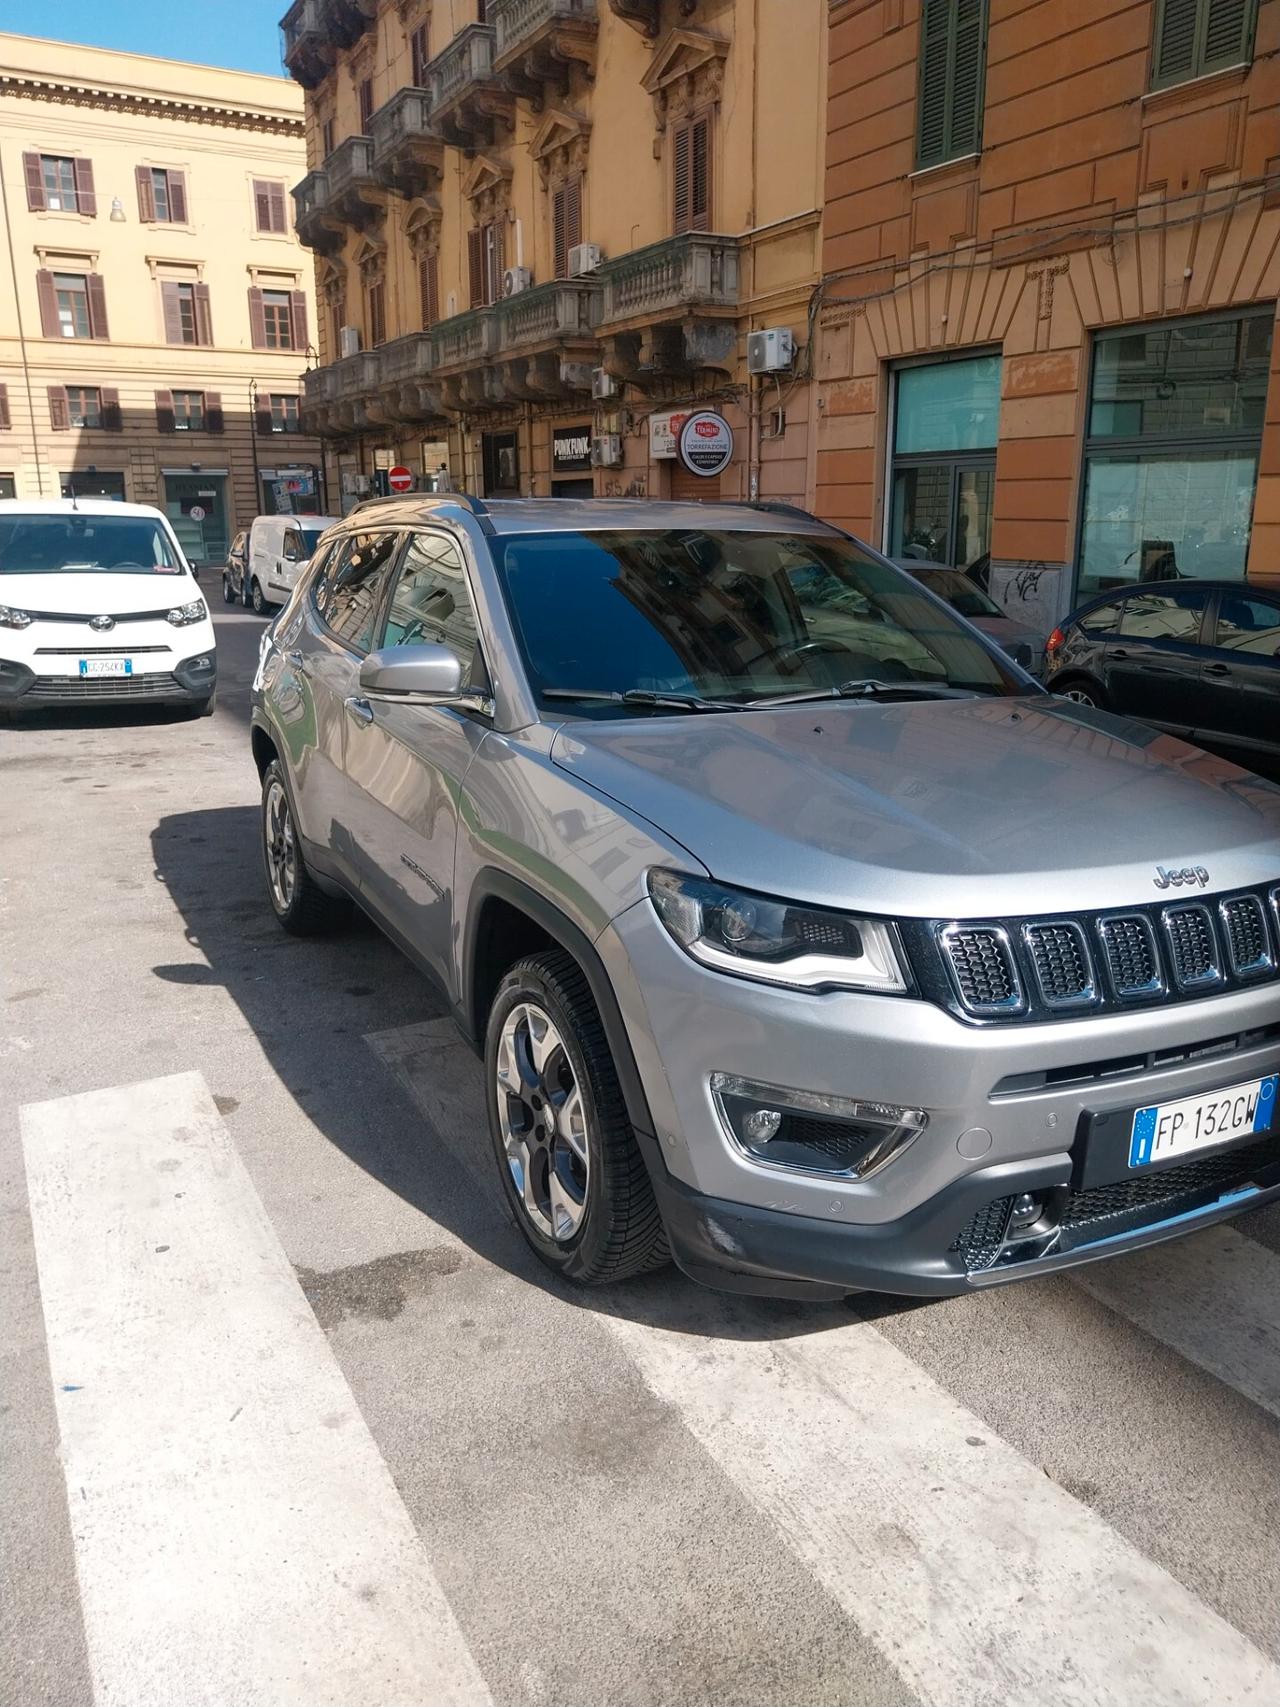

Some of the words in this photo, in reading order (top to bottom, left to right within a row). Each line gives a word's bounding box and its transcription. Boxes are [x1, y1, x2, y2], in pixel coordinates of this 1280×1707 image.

[1152, 865, 1209, 889] Jeep
[1155, 1112, 1184, 1150] FP
[1194, 1091, 1259, 1139] 132GW
